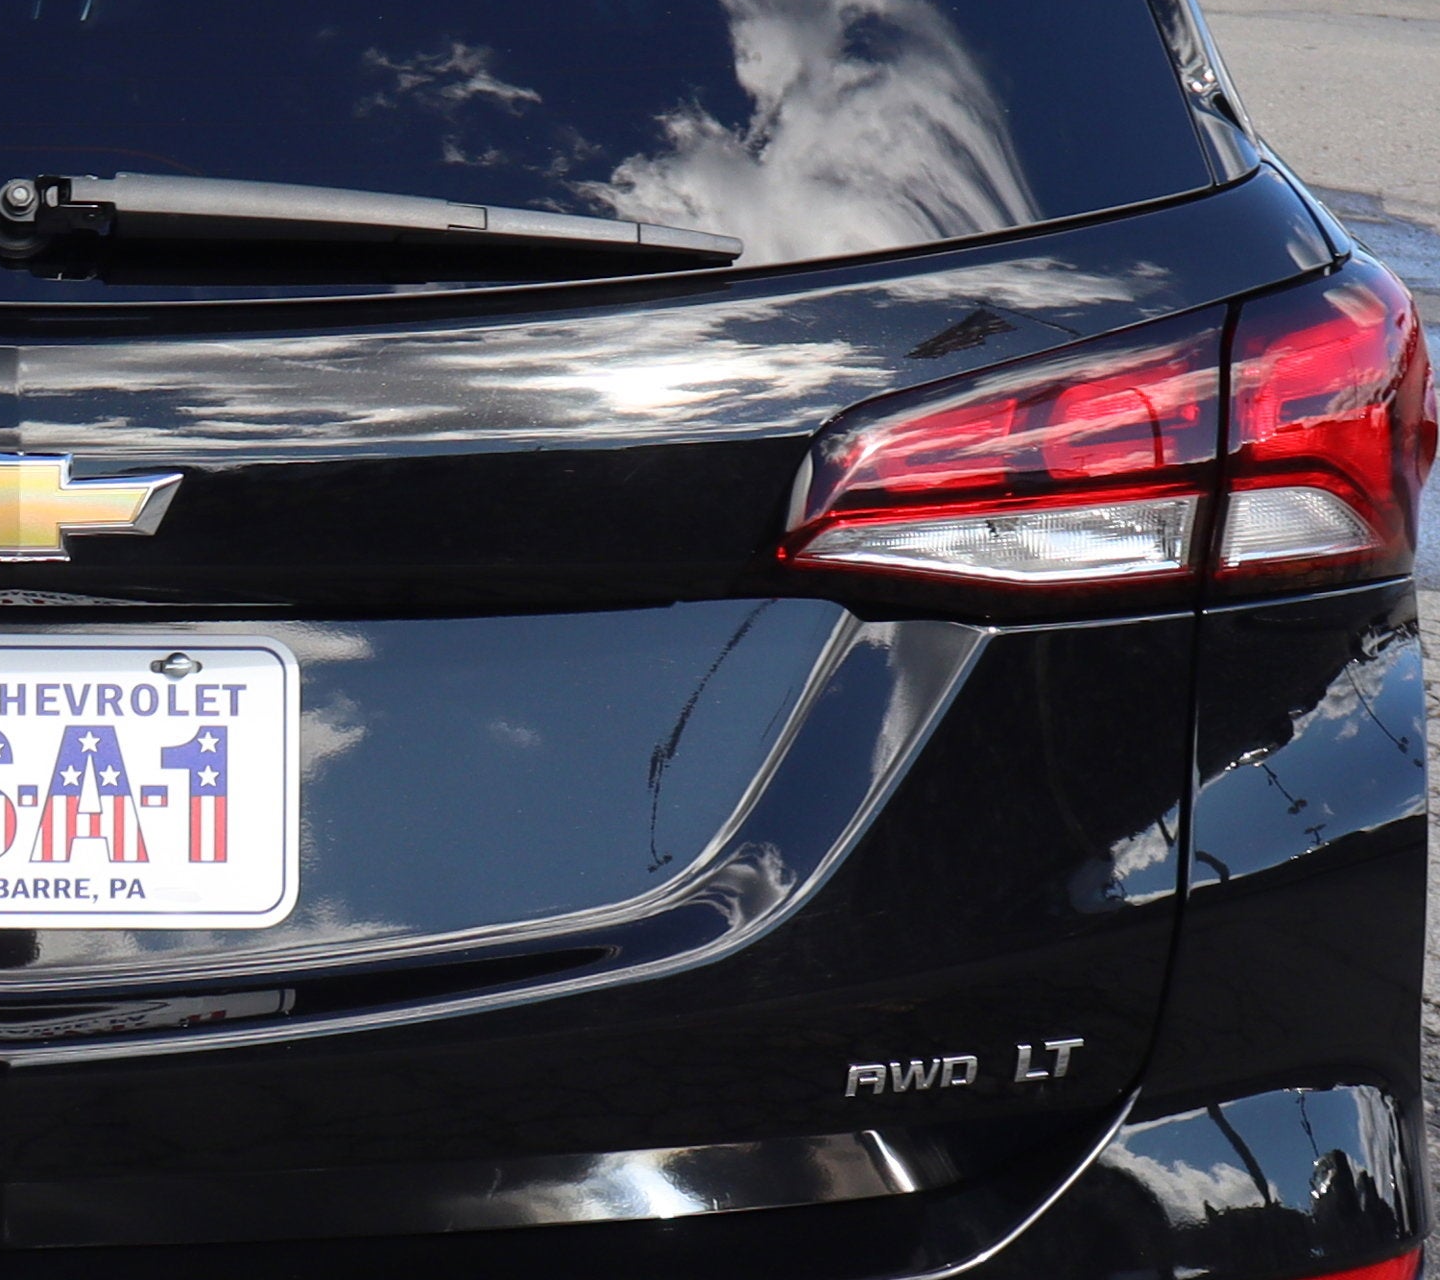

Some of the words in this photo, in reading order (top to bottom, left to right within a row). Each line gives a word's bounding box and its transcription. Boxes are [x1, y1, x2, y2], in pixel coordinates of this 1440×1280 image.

[108, 876, 147, 901] PA
[844, 1054, 979, 1098] AWD
[1014, 1037, 1085, 1084] LT
